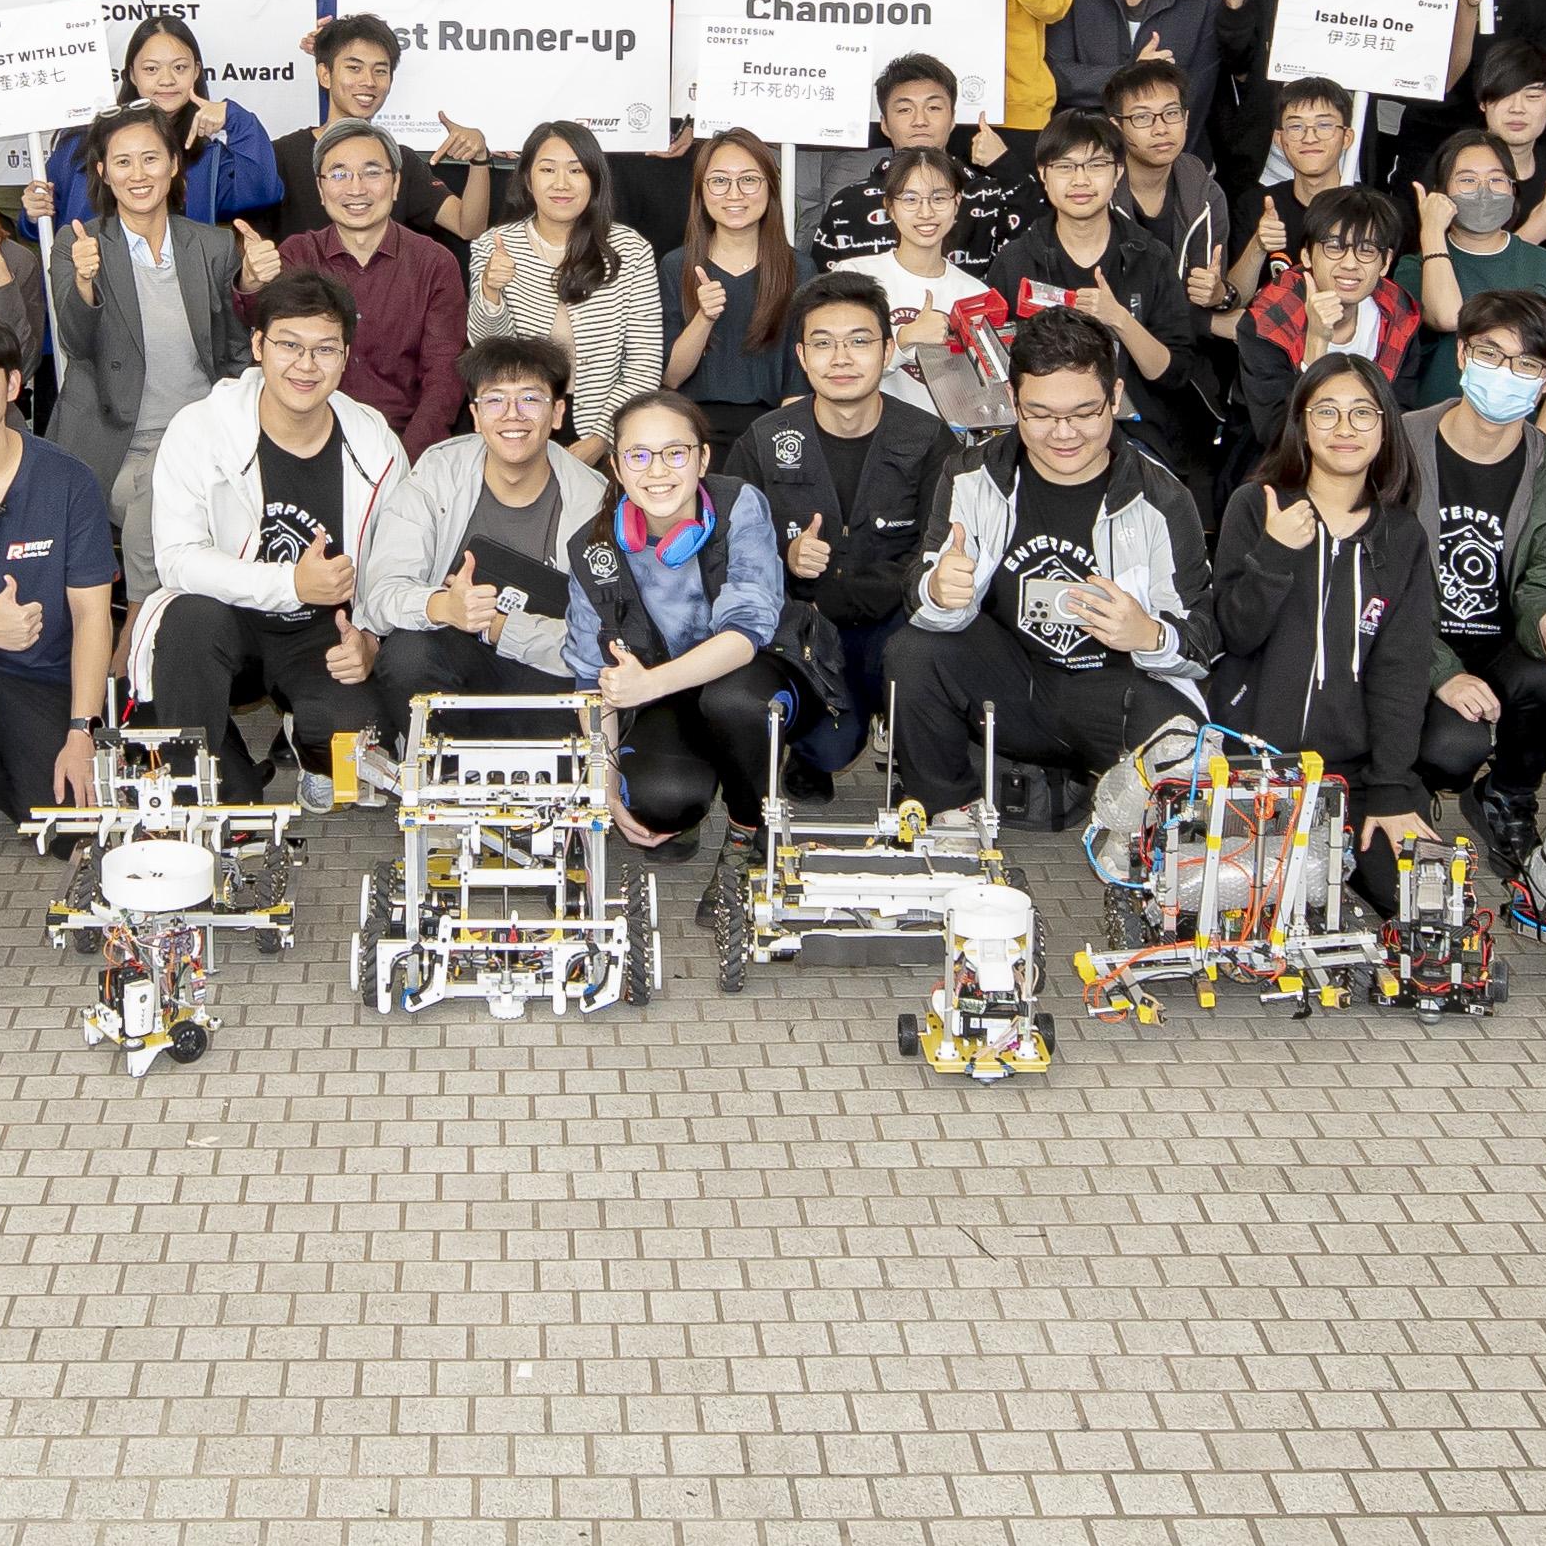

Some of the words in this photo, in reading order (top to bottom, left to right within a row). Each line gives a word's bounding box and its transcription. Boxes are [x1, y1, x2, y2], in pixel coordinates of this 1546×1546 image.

[102, 3, 201, 22] CONTEST
[1315, 9, 1378, 28] Isabella
[1383, 17, 1414, 32] One
[396, 21, 429, 51] st
[439, 20, 636, 59] Runner-up
[707, 26, 738, 35] ROBOT
[741, 28, 774, 36] DESIGN
[1327, 29, 1396, 52] 伊莎貝拉
[707, 37, 749, 46] CONTEST
[18, 47, 55, 63] WITH
[59, 41, 97, 56] LOVE
[222, 62, 295, 82] Award
[743, 61, 827, 78] Endurance
[733, 80, 835, 101] 打不死的小強
